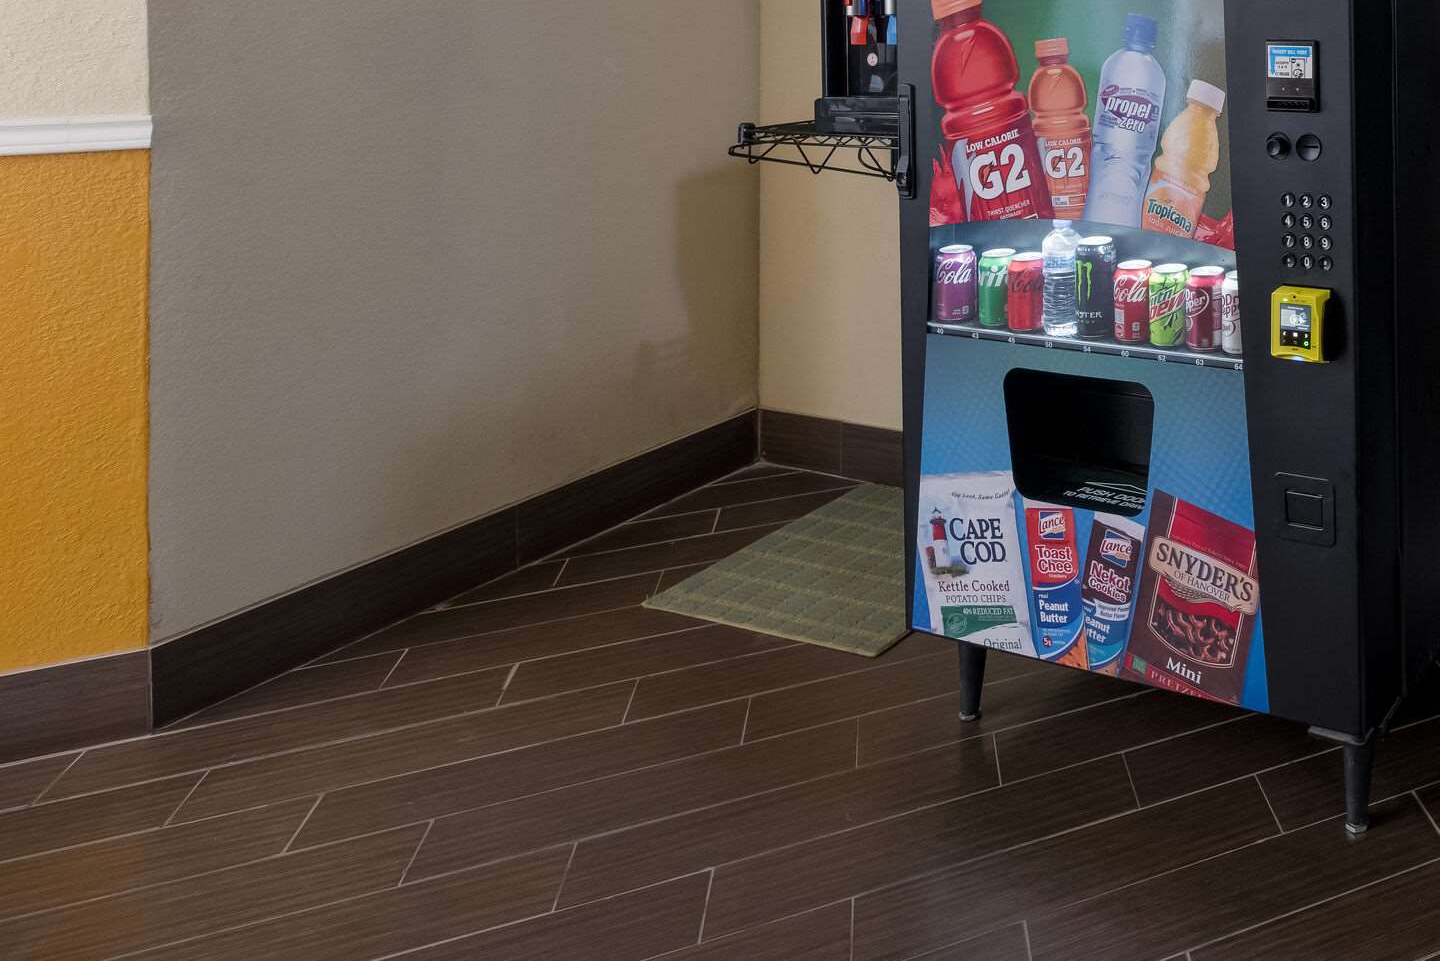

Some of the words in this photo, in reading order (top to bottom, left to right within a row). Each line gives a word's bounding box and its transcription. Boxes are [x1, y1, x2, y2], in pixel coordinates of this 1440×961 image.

[1104, 96, 1152, 119] propel
[1118, 117, 1146, 134] zero
[965, 139, 985, 153] LOW
[984, 129, 1021, 148] CALORIE
[1045, 146, 1085, 179] G2
[969, 143, 1032, 200] G2
[1284, 194, 1291, 206] 1
[1302, 195, 1309, 206] 2
[1320, 196, 1328, 207] 3
[1147, 198, 1192, 233] Tropicana
[1284, 215, 1291, 226] 4
[1303, 216, 1309, 227] 5
[1321, 217, 1328, 228] 6
[1285, 235, 1292, 247] 7
[1303, 236, 1310, 247] 8
[1321, 237, 1328, 248] 9
[1303, 256, 1310, 267] 0
[936, 255, 975, 285] Cola
[1114, 274, 1149, 303] Cola
[1075, 493, 1121, 505] RETRIEVE
[1077, 486, 1116, 498] PUSH
[950, 517, 1004, 542] CAPE
[1039, 515, 1064, 535] Lance
[960, 540, 1006, 566] COD
[1036, 544, 1072, 561] Toast
[1101, 539, 1133, 554] Lance
[1037, 559, 1072, 574] Chee
[1156, 542, 1253, 603] SNYDER'S
[1091, 559, 1131, 593] Nekot
[938, 580, 969, 593] Kettle
[971, 580, 1010, 592] Cooked
[1088, 577, 1127, 603] Cookies
[1173, 568, 1189, 580] OF
[1188, 576, 1230, 602] HANOVER
[946, 594, 979, 604] POTATO
[980, 594, 1007, 604] CHIPS
[1038, 599, 1069, 612] Peanut
[972, 607, 1002, 615] REDUCED
[1003, 607, 1014, 615] FAT
[1040, 611, 1068, 624] Butter
[983, 638, 1022, 650] Original
[1165, 656, 1201, 684] Mini
